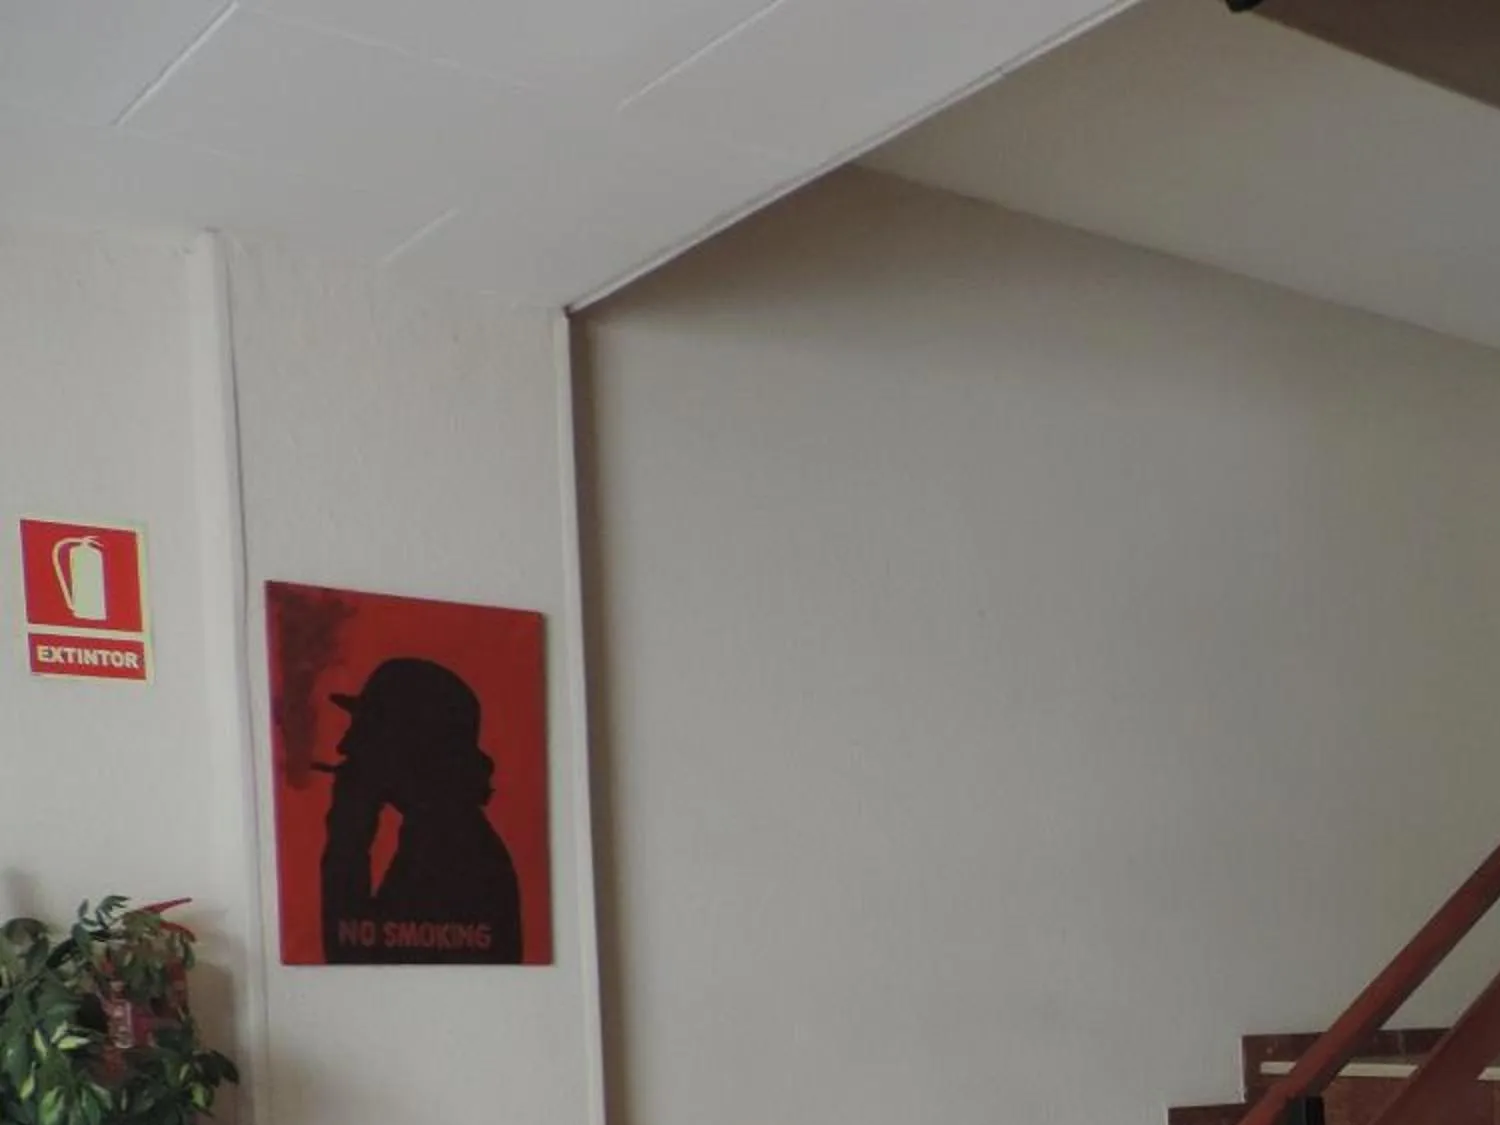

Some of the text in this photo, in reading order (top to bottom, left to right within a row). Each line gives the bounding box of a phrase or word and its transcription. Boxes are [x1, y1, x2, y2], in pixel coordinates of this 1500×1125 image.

[37, 646, 139, 669] EXTINTOR
[338, 919, 492, 949] NO SMOKING
